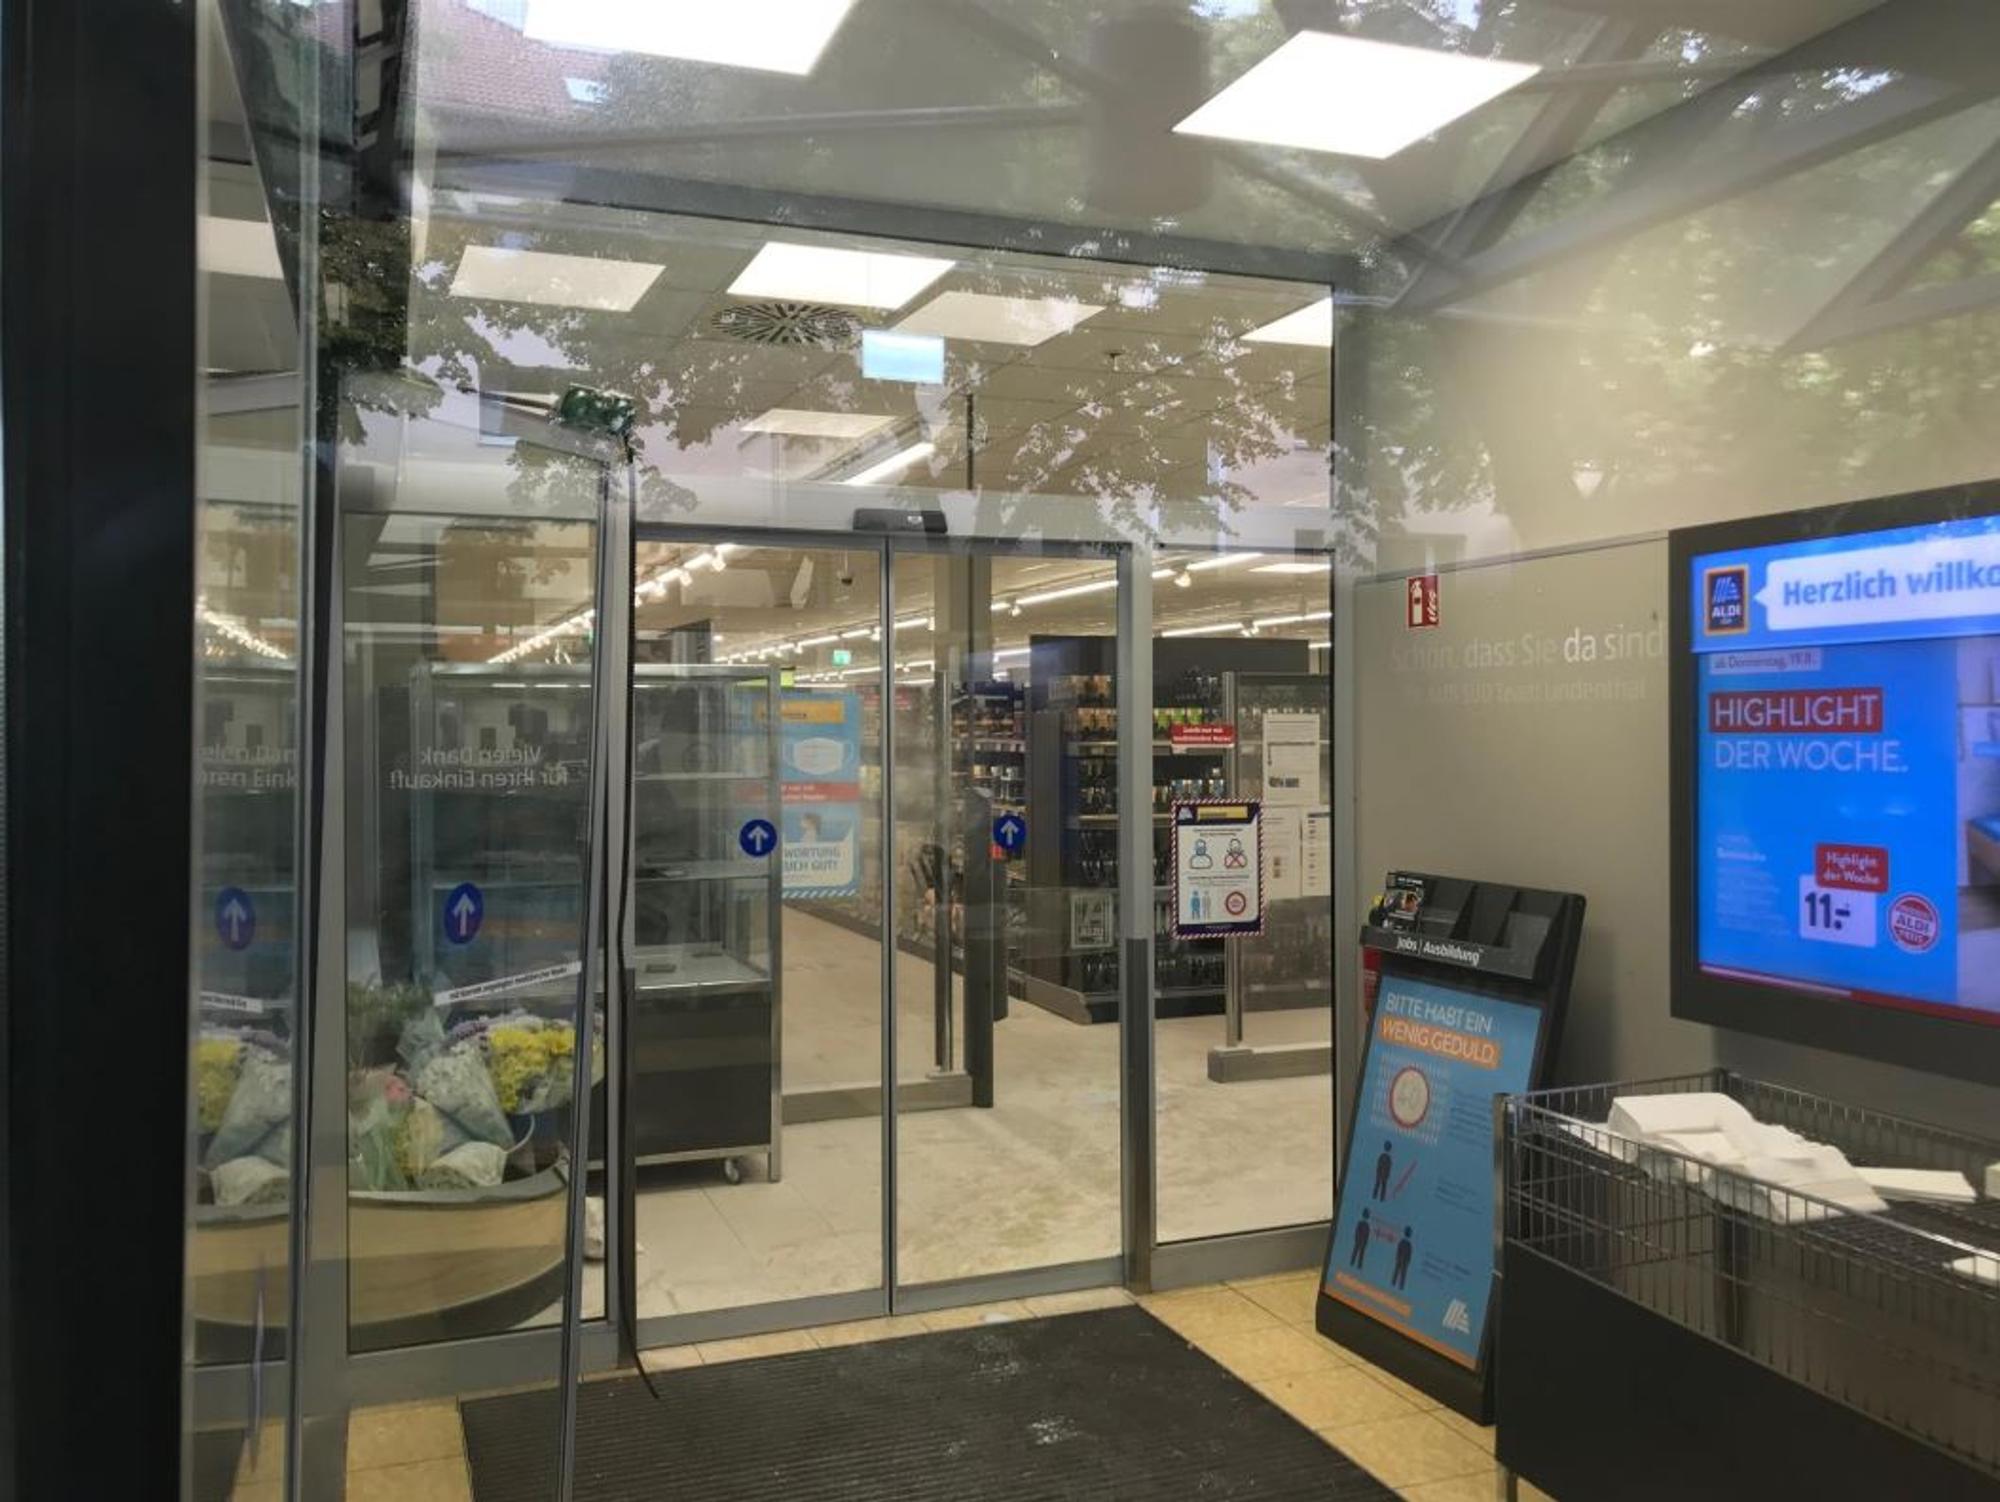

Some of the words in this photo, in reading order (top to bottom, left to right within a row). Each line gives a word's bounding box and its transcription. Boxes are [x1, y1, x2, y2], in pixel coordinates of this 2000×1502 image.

[1783, 568, 1896, 607] Herzlich
[1711, 605, 1741, 618] ALDI
[1464, 637, 1515, 669] dass
[1521, 632, 1558, 666] Sie
[1564, 627, 1597, 663] da
[1603, 623, 1665, 661] sind
[1714, 694, 1879, 728] HIGHLIGHT
[1716, 740, 1770, 769] DER
[1777, 739, 1909, 773] WOCHE.
[1824, 867, 1840, 880] der
[1843, 871, 1879, 885] Woche
[1826, 851, 1877, 870] Highlight
[1896, 914, 1930, 933] ALDI
[1397, 936, 1417, 952] Jobs
[1424, 941, 1480, 968] Ausbildung
[1385, 992, 1424, 1017] BITTE
[1424, 1001, 1465, 1029] HABT
[1464, 1010, 1493, 1034] EIN
[1382, 1018, 1429, 1047] WENIG
